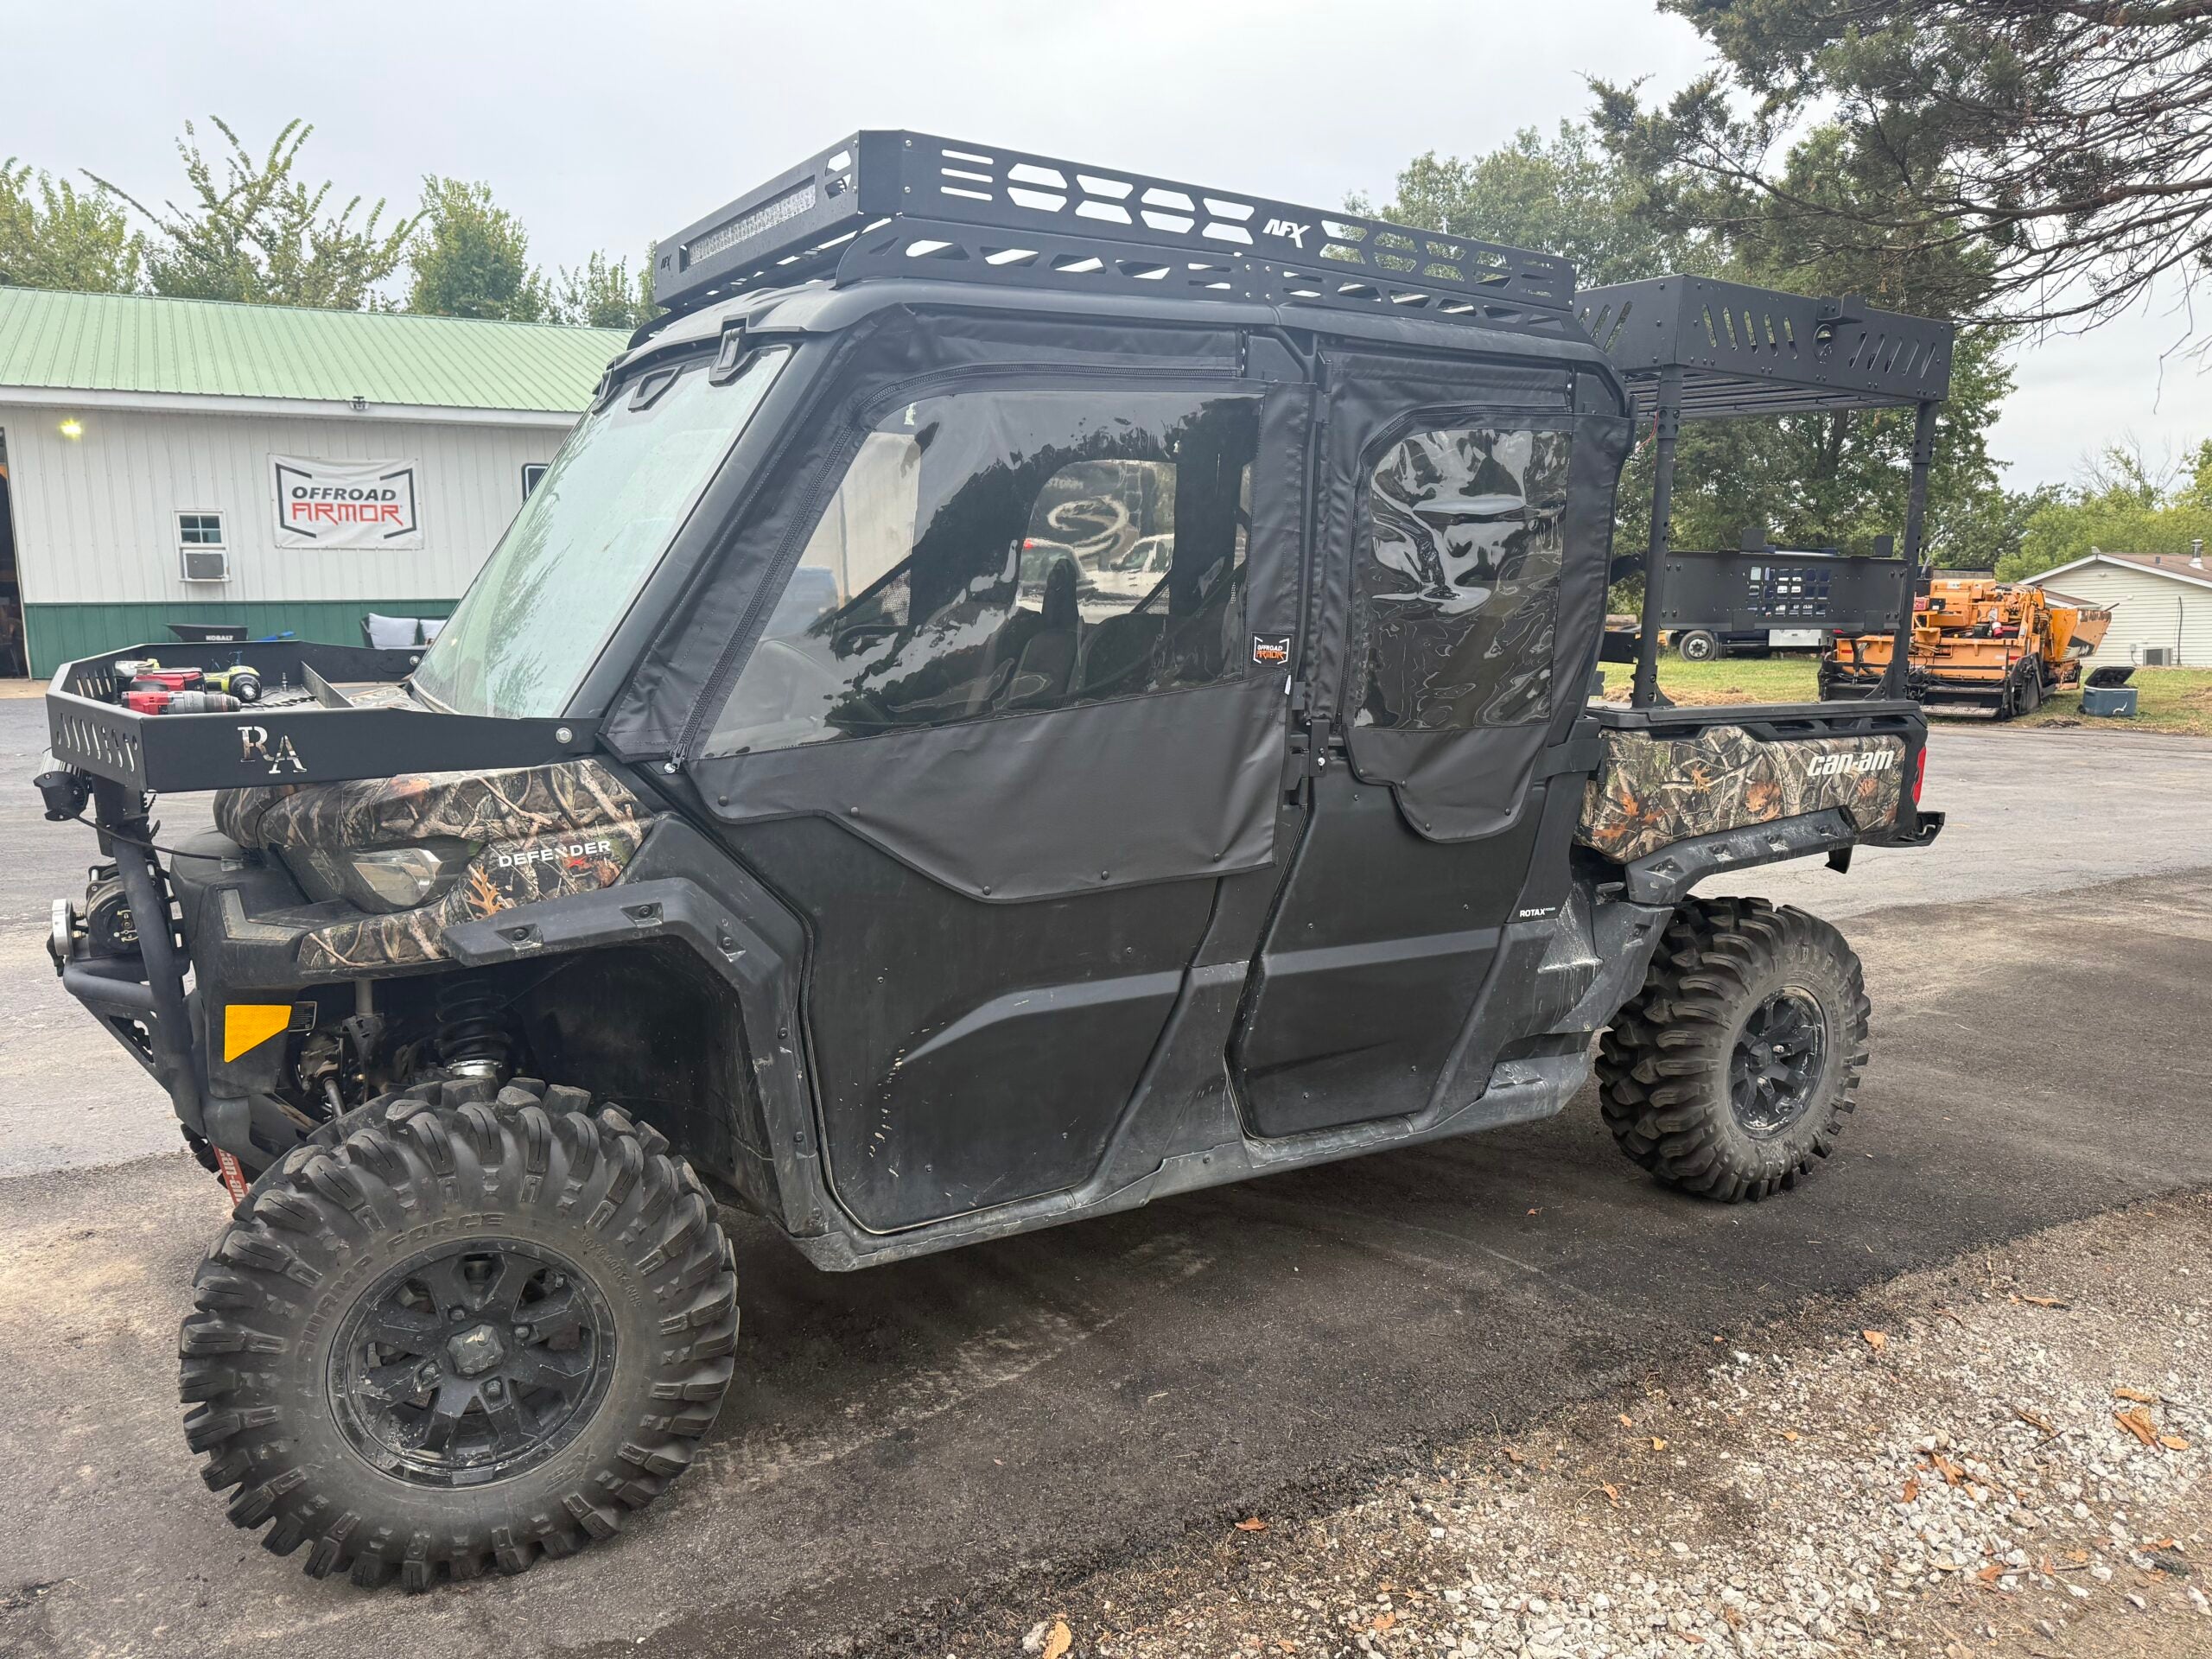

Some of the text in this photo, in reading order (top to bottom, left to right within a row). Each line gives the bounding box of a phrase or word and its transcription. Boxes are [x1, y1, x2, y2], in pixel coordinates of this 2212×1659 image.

[291, 486, 397, 501] OFFROAD
[292, 502, 404, 526] ARMOR
[1807, 749, 1895, 777] can-am
[498, 840, 612, 868] DEFENDER
[1519, 907, 1545, 918] ROTAX
